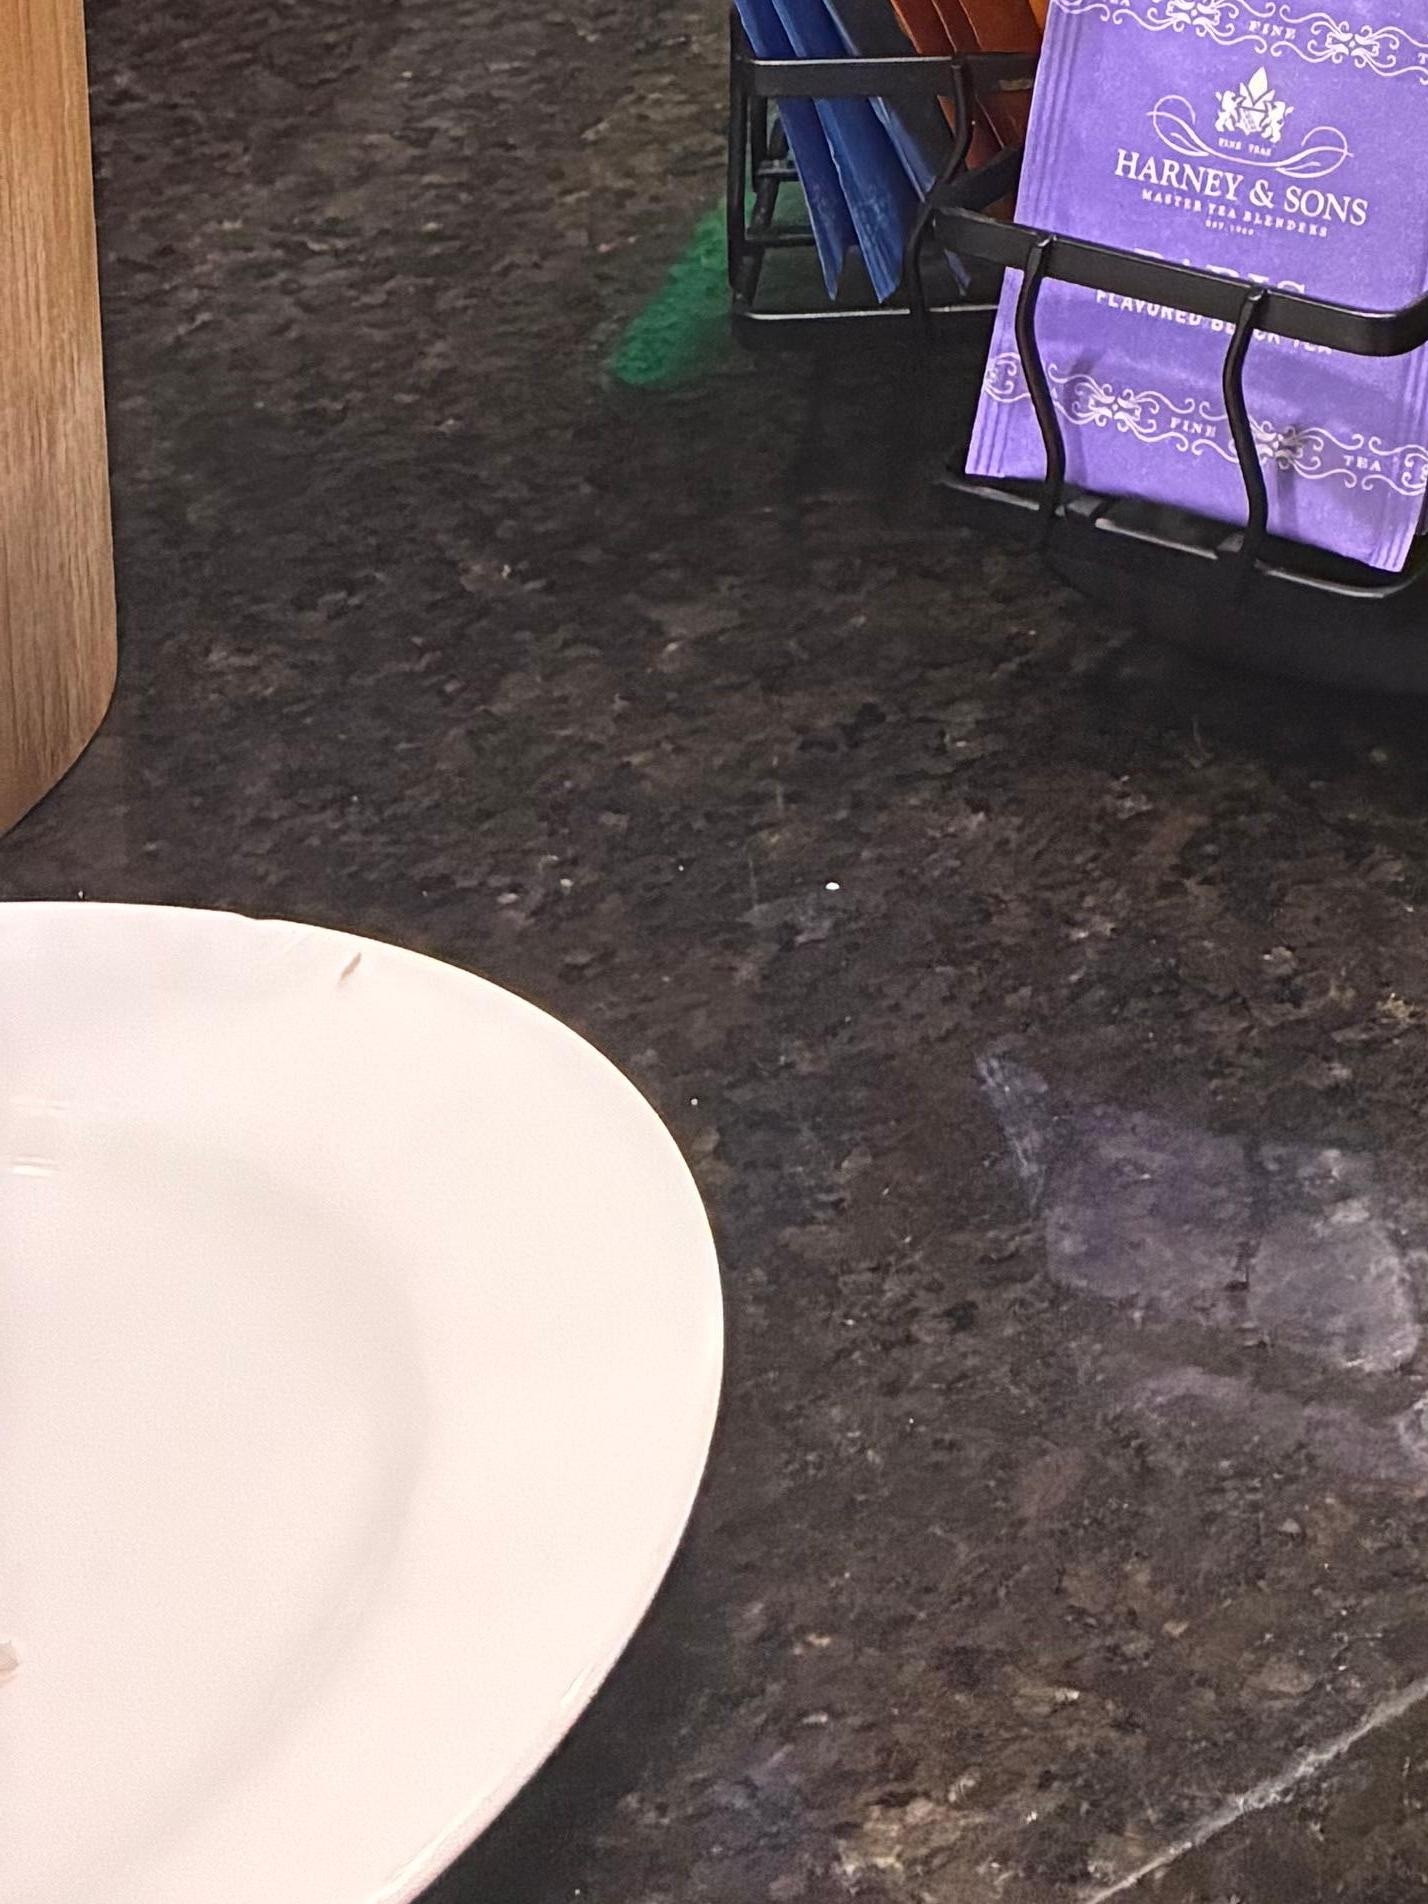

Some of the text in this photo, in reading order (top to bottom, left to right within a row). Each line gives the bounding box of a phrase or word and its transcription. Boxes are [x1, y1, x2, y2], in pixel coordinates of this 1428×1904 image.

[1247, 19, 1297, 40] FINE
[1114, 148, 1369, 227] HARNEY & SONS
[1141, 188, 1329, 238] MASTER TEA BLENDERS
[1170, 417, 1382, 473] FINE TEA
